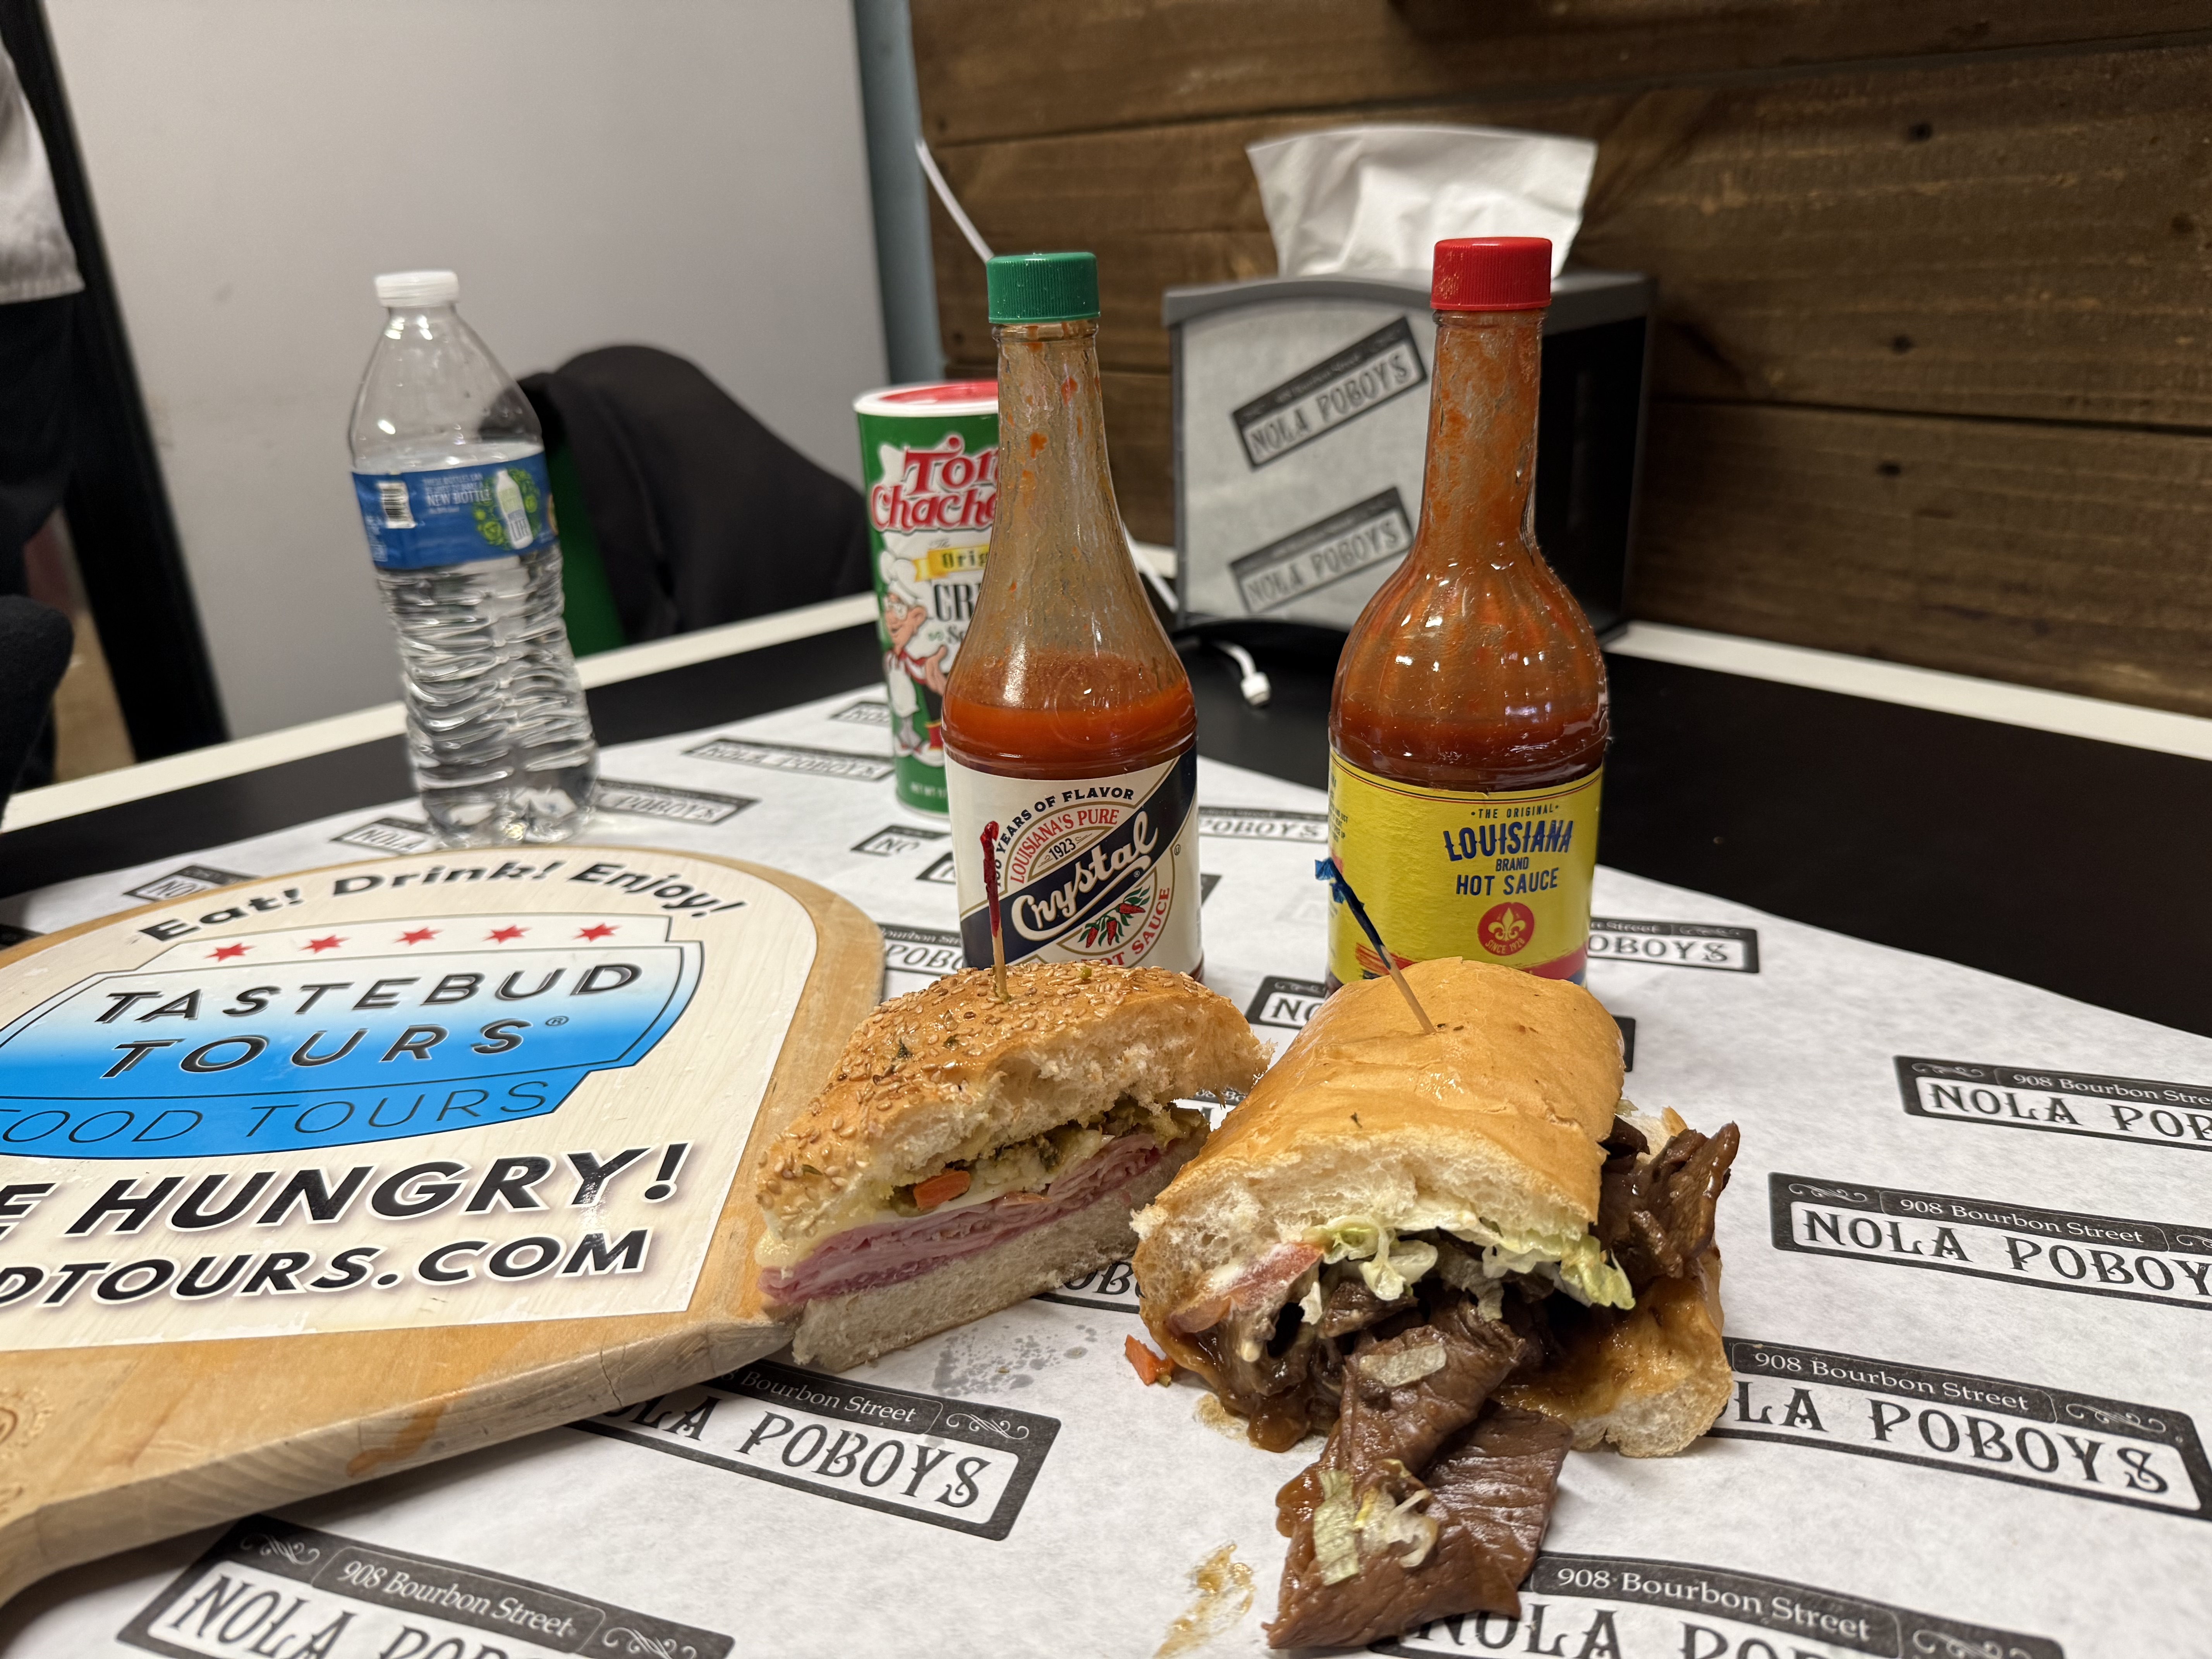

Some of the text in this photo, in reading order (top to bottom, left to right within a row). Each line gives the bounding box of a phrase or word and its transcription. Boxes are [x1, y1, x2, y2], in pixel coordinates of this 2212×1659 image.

[1249, 409, 1313, 459] NOLA
[1316, 352, 1410, 424] POBOYS
[426, 493, 450, 506] NEW
[1247, 563, 1306, 606] NOLA
[1310, 517, 1401, 580] POBOYS
[934, 583, 981, 620] CR
[996, 809, 1032, 854] YEARS
[1034, 796, 1056, 812] OF
[1062, 787, 1134, 803] FLAVOR
[1443, 820, 1573, 862] LOUISIANA
[1478, 804, 1553, 819] THE ORIGINAL
[1010, 809, 1119, 884] LOUISIANA'S PURE
[1011, 811, 1159, 941] Crystal
[1049, 838, 1076, 860] 1923
[1495, 857, 1529, 872] BRAND
[137, 859, 748, 942] Eat! Drink! Enjoy!
[1456, 867, 1559, 896] HOT SAUCE
[1082, 951, 1125, 965] OT
[1131, 887, 1170, 955] SAUCE
[1485, 939, 1506, 954] SINCE
[94, 963, 643, 1024] TASTEBUD
[246, 1080, 549, 1138] TOURS
[1928, 1083, 2083, 1127] NOLA
[2013, 1074, 2052, 1087] 908
[2059, 1078, 2159, 1099] Bourbon
[63, 1142, 690, 1235] HUNGRY!
[1801, 1208, 1974, 1263] NOLA
[1899, 1198, 2145, 1243] 908 Bourbon Street
[740, 1370, 841, 1407] Bourbon
[842, 1396, 917, 1424] Street
[1753, 1352, 2029, 1411] 908 Bourbon Street
[603, 1395, 992, 1508] LA POBOYS
[1865, 1397, 2170, 1495] POBOYS
[165, 1573, 359, 1659] NOLA
[337, 1559, 573, 1639] 908 Bourbon Street
[1557, 1567, 1871, 1642] 908 Bourbon Street
